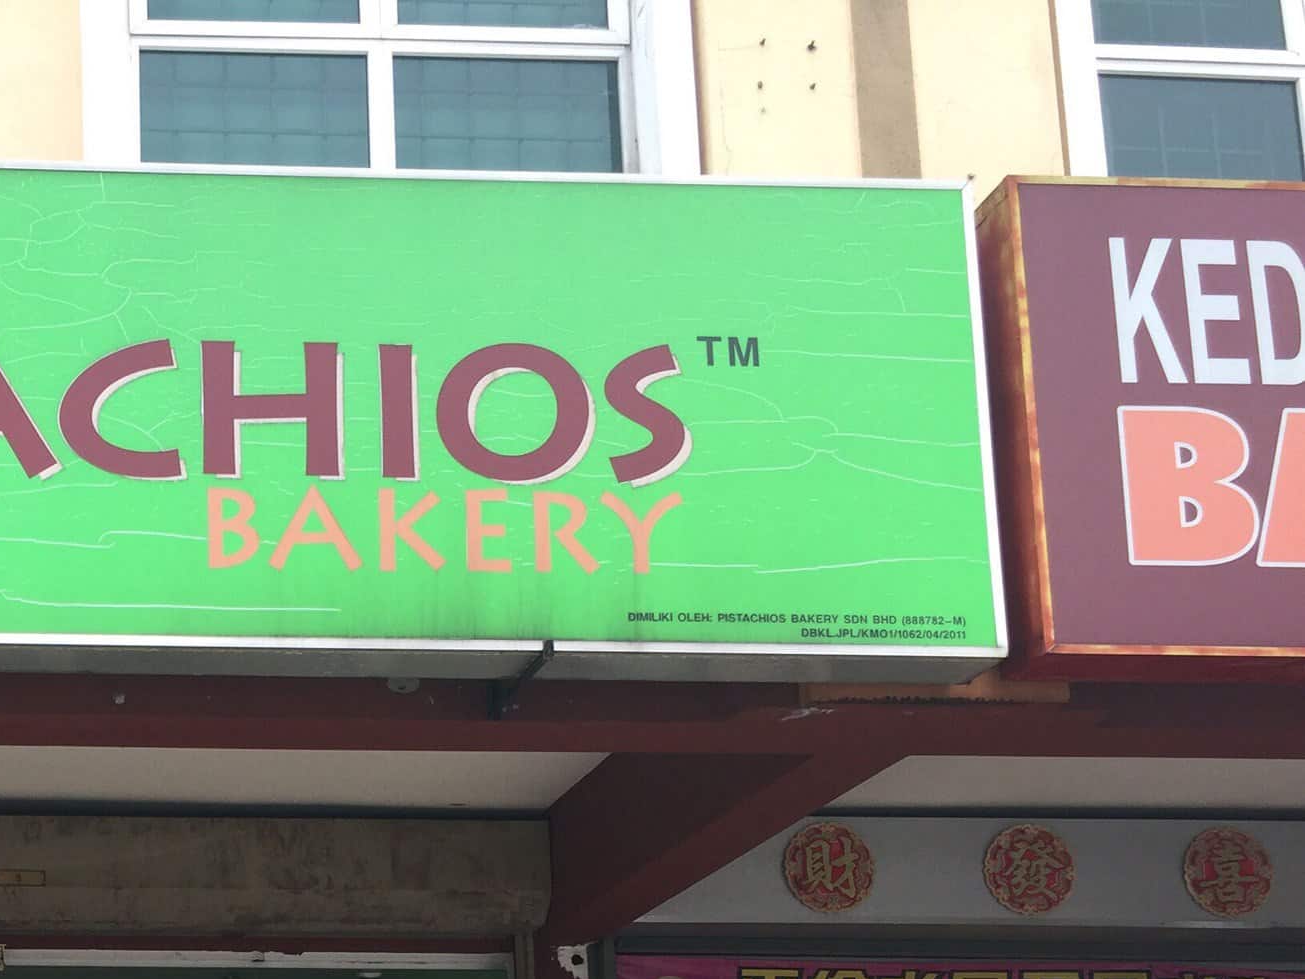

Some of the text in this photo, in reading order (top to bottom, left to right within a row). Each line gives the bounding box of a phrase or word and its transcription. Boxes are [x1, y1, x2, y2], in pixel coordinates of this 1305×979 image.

[206, 484, 683, 576] BAKERY
[627, 612, 674, 623] DIMILIKI
[677, 612, 713, 623] OLEH:
[717, 613, 787, 624] PISTACHIOS
[790, 614, 839, 624] BAKERY
[843, 615, 869, 625] SDN
[872, 615, 897, 625] BHD
